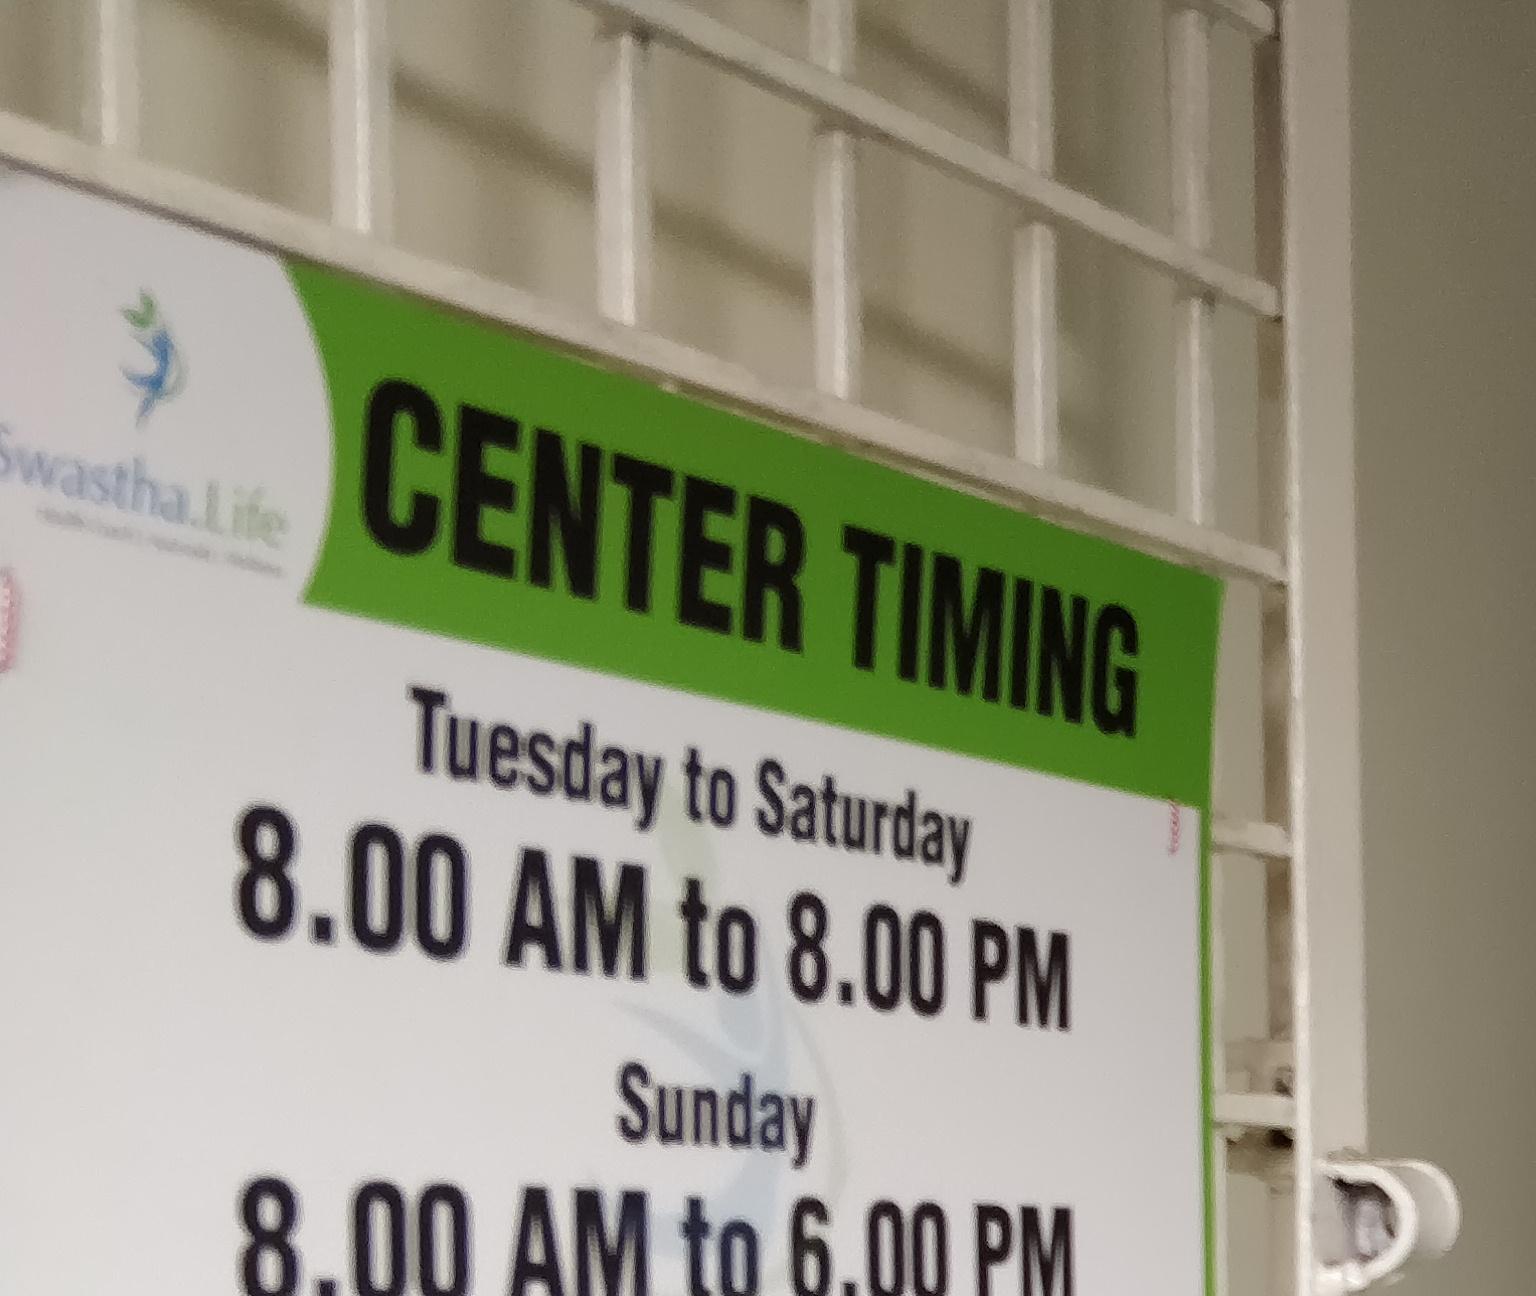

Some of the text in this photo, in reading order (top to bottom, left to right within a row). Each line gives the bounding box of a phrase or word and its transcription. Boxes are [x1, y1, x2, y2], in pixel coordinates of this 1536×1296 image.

[360, 378, 1142, 739] CENTER TIMING
[408, 685, 972, 887] Tuesday to Saturday
[235, 804, 1072, 1032] 8.00 AM to 8.00 PM
[617, 1060, 816, 1169] Sunday
